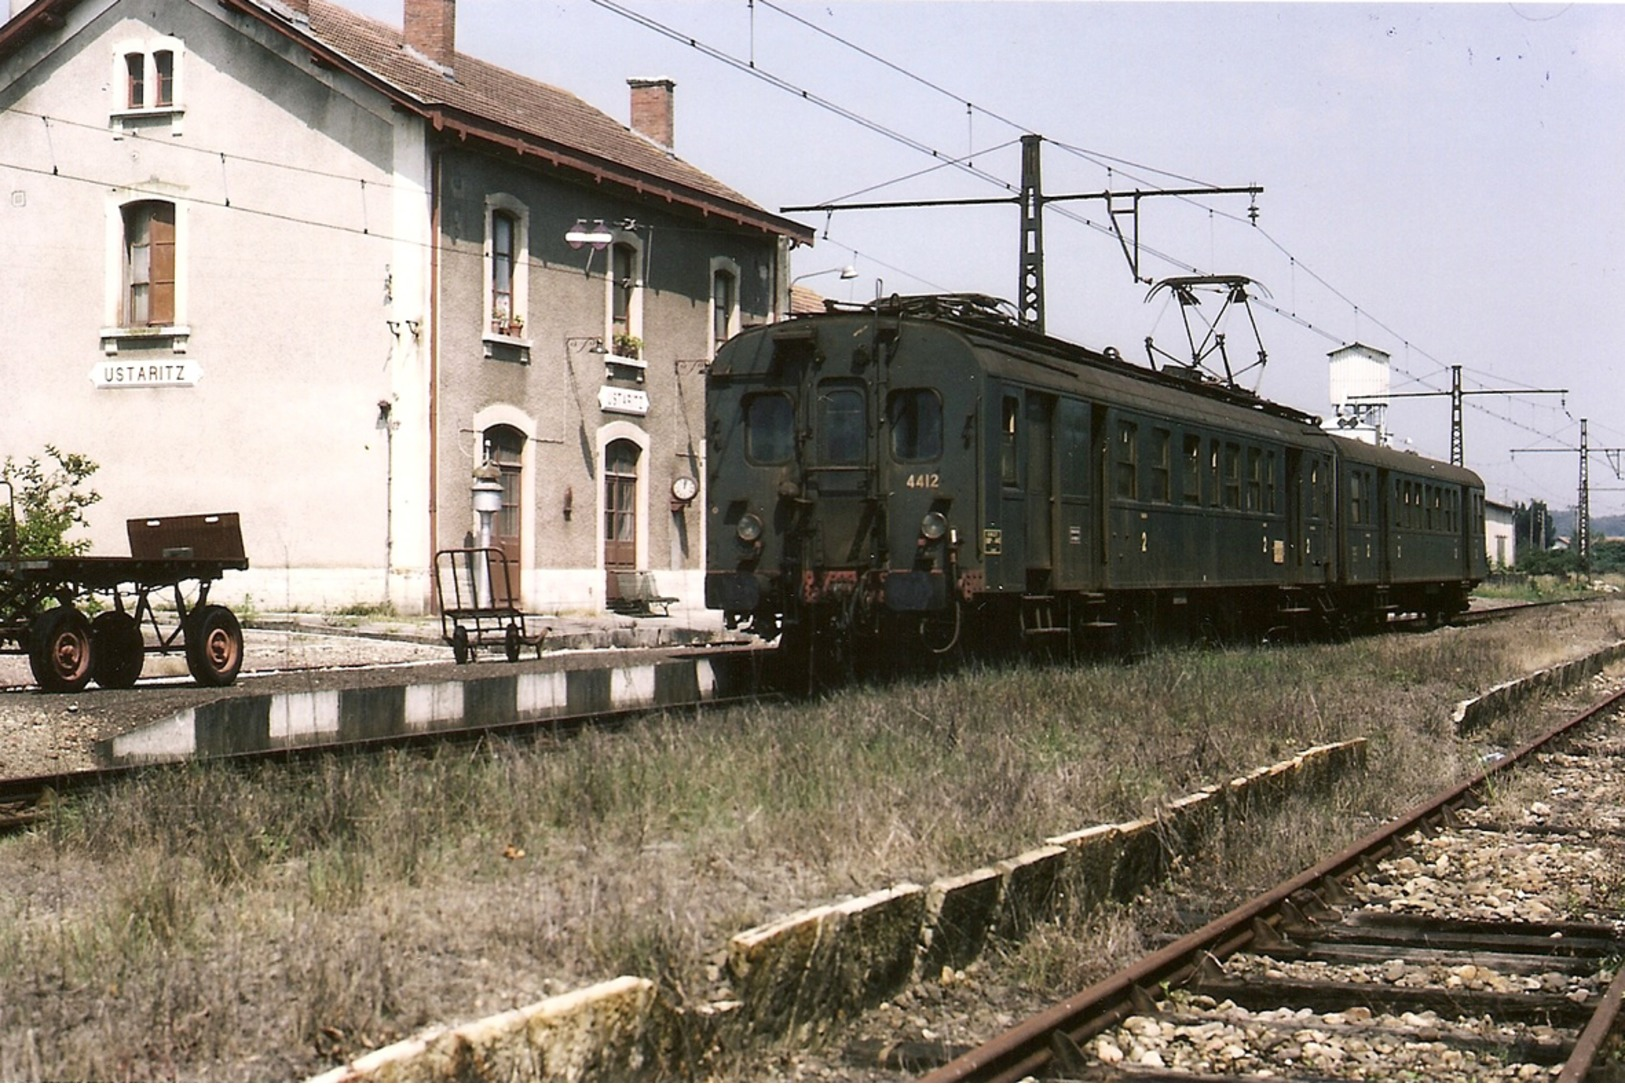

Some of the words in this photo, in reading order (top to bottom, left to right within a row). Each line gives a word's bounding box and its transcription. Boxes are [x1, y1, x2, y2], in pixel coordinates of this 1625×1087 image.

[104, 365, 185, 382] USTARITZ
[906, 473, 939, 488] 4412
[1141, 531, 1148, 552] 2
